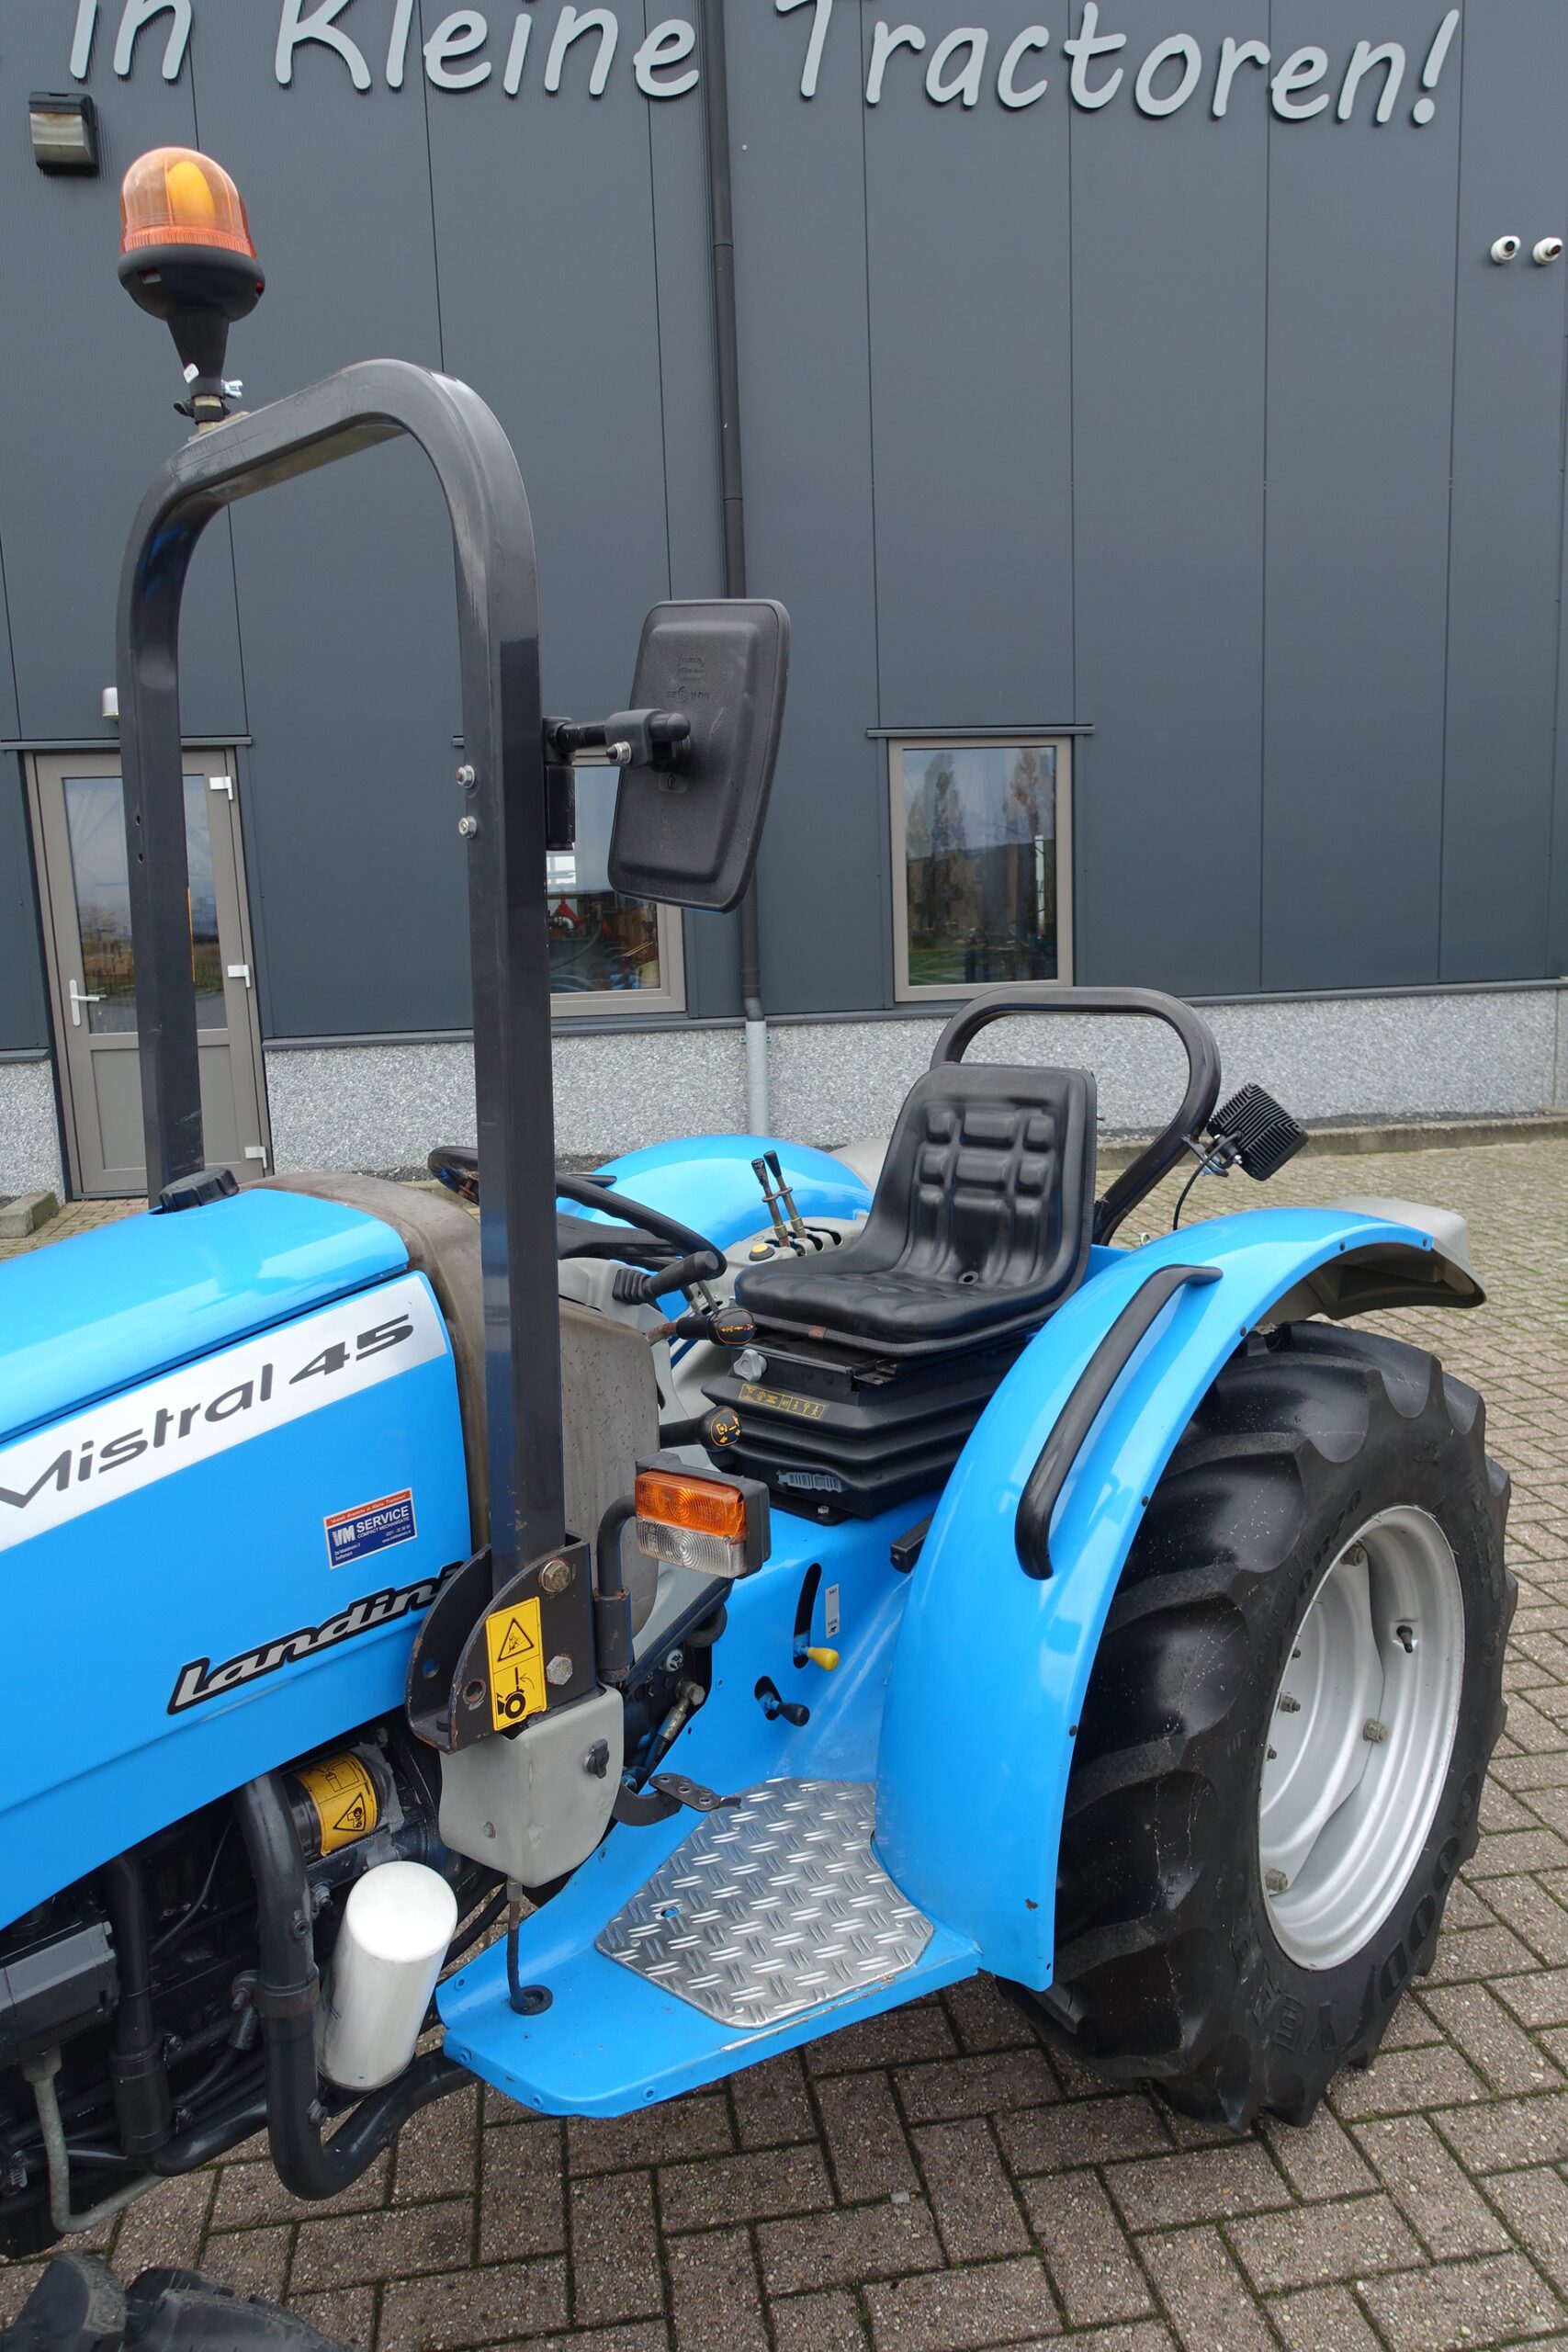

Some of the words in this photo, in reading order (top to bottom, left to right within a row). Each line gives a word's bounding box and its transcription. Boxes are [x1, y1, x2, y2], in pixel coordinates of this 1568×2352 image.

[276, 0, 700, 96] Kleine
[775, 0, 1461, 124] Tractoren!
[0, 1363, 274, 1509] Mistral
[288, 1313, 414, 1385] 45
[355, 1505, 410, 1533] SERVICE
